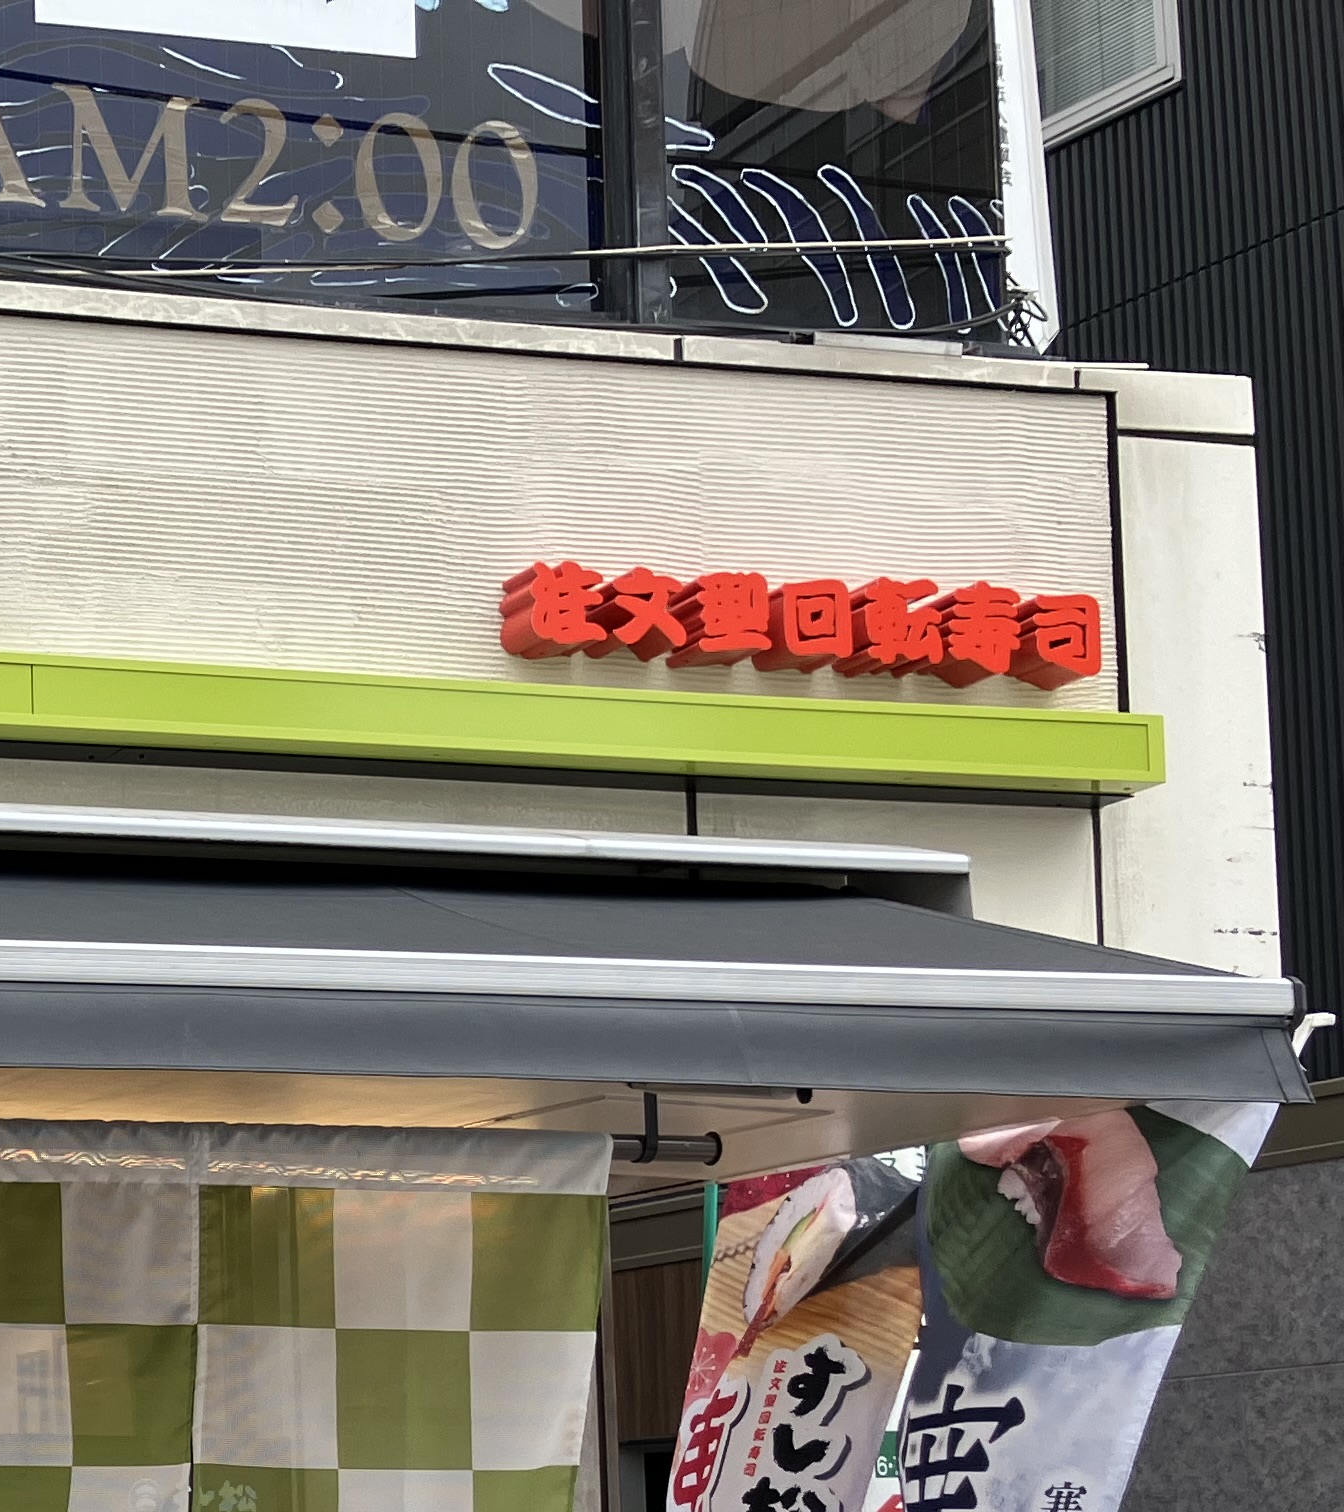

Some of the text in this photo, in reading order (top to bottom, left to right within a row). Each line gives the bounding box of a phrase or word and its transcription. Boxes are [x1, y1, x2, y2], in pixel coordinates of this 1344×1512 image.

[502, 560, 1102, 688] 注文型回転寿司
